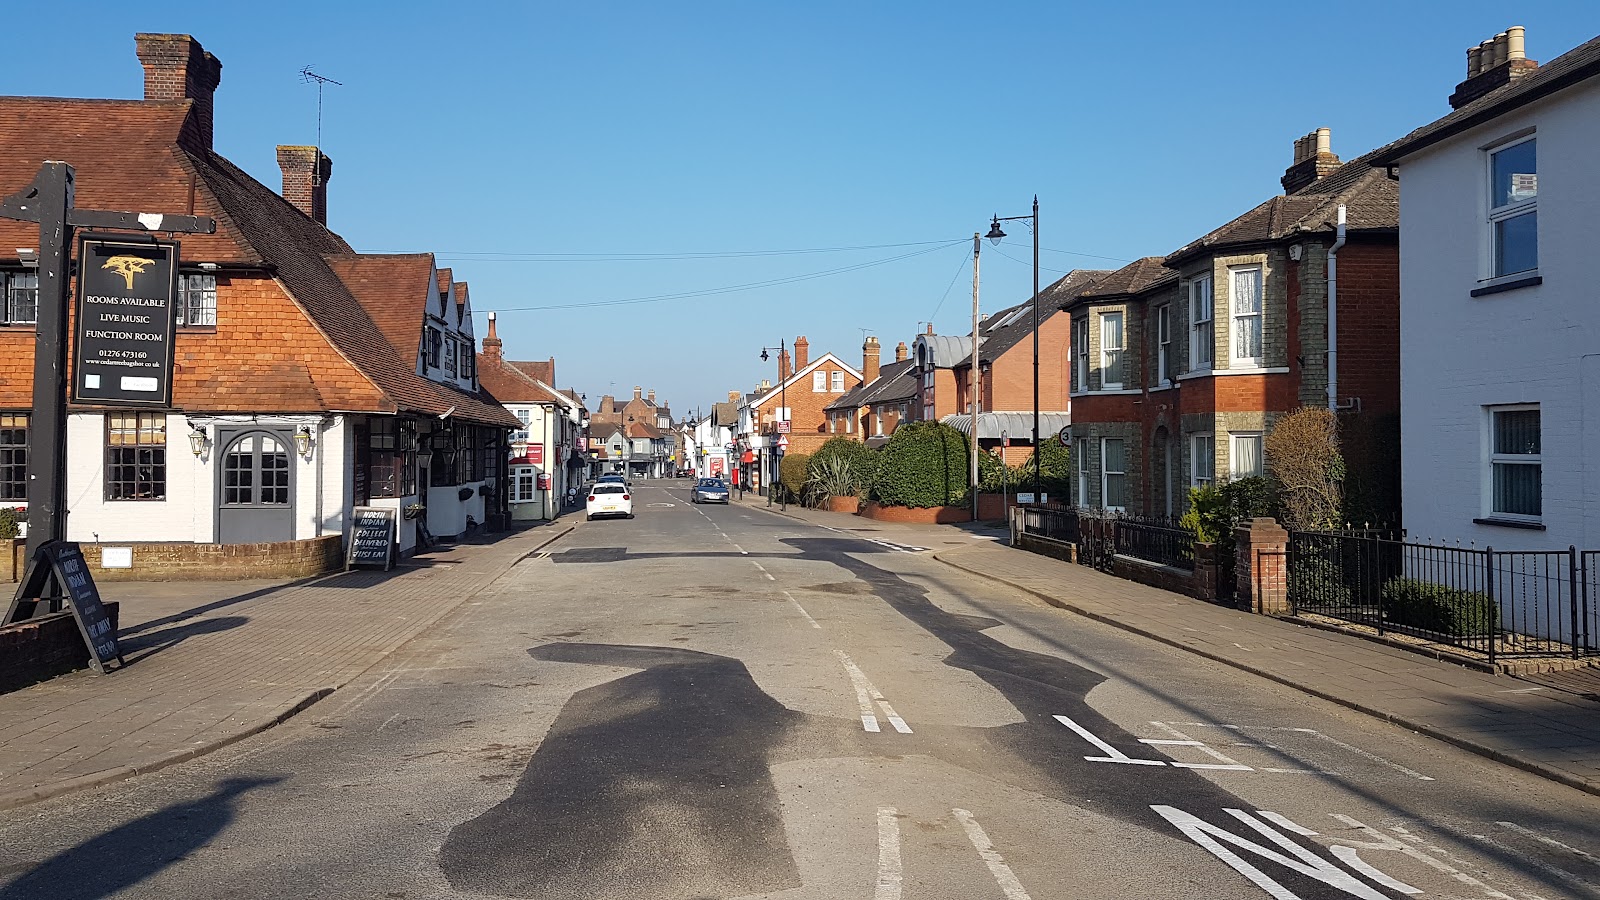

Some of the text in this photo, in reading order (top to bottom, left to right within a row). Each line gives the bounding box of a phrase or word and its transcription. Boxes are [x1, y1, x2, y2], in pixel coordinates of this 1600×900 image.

[87, 296, 165, 307] ROOMS AVAILABLE
[100, 313, 150, 323] LIVE MUSIC
[86, 330, 162, 341] FUNCTION ROOM
[99, 350, 147, 359] 01276 473160
